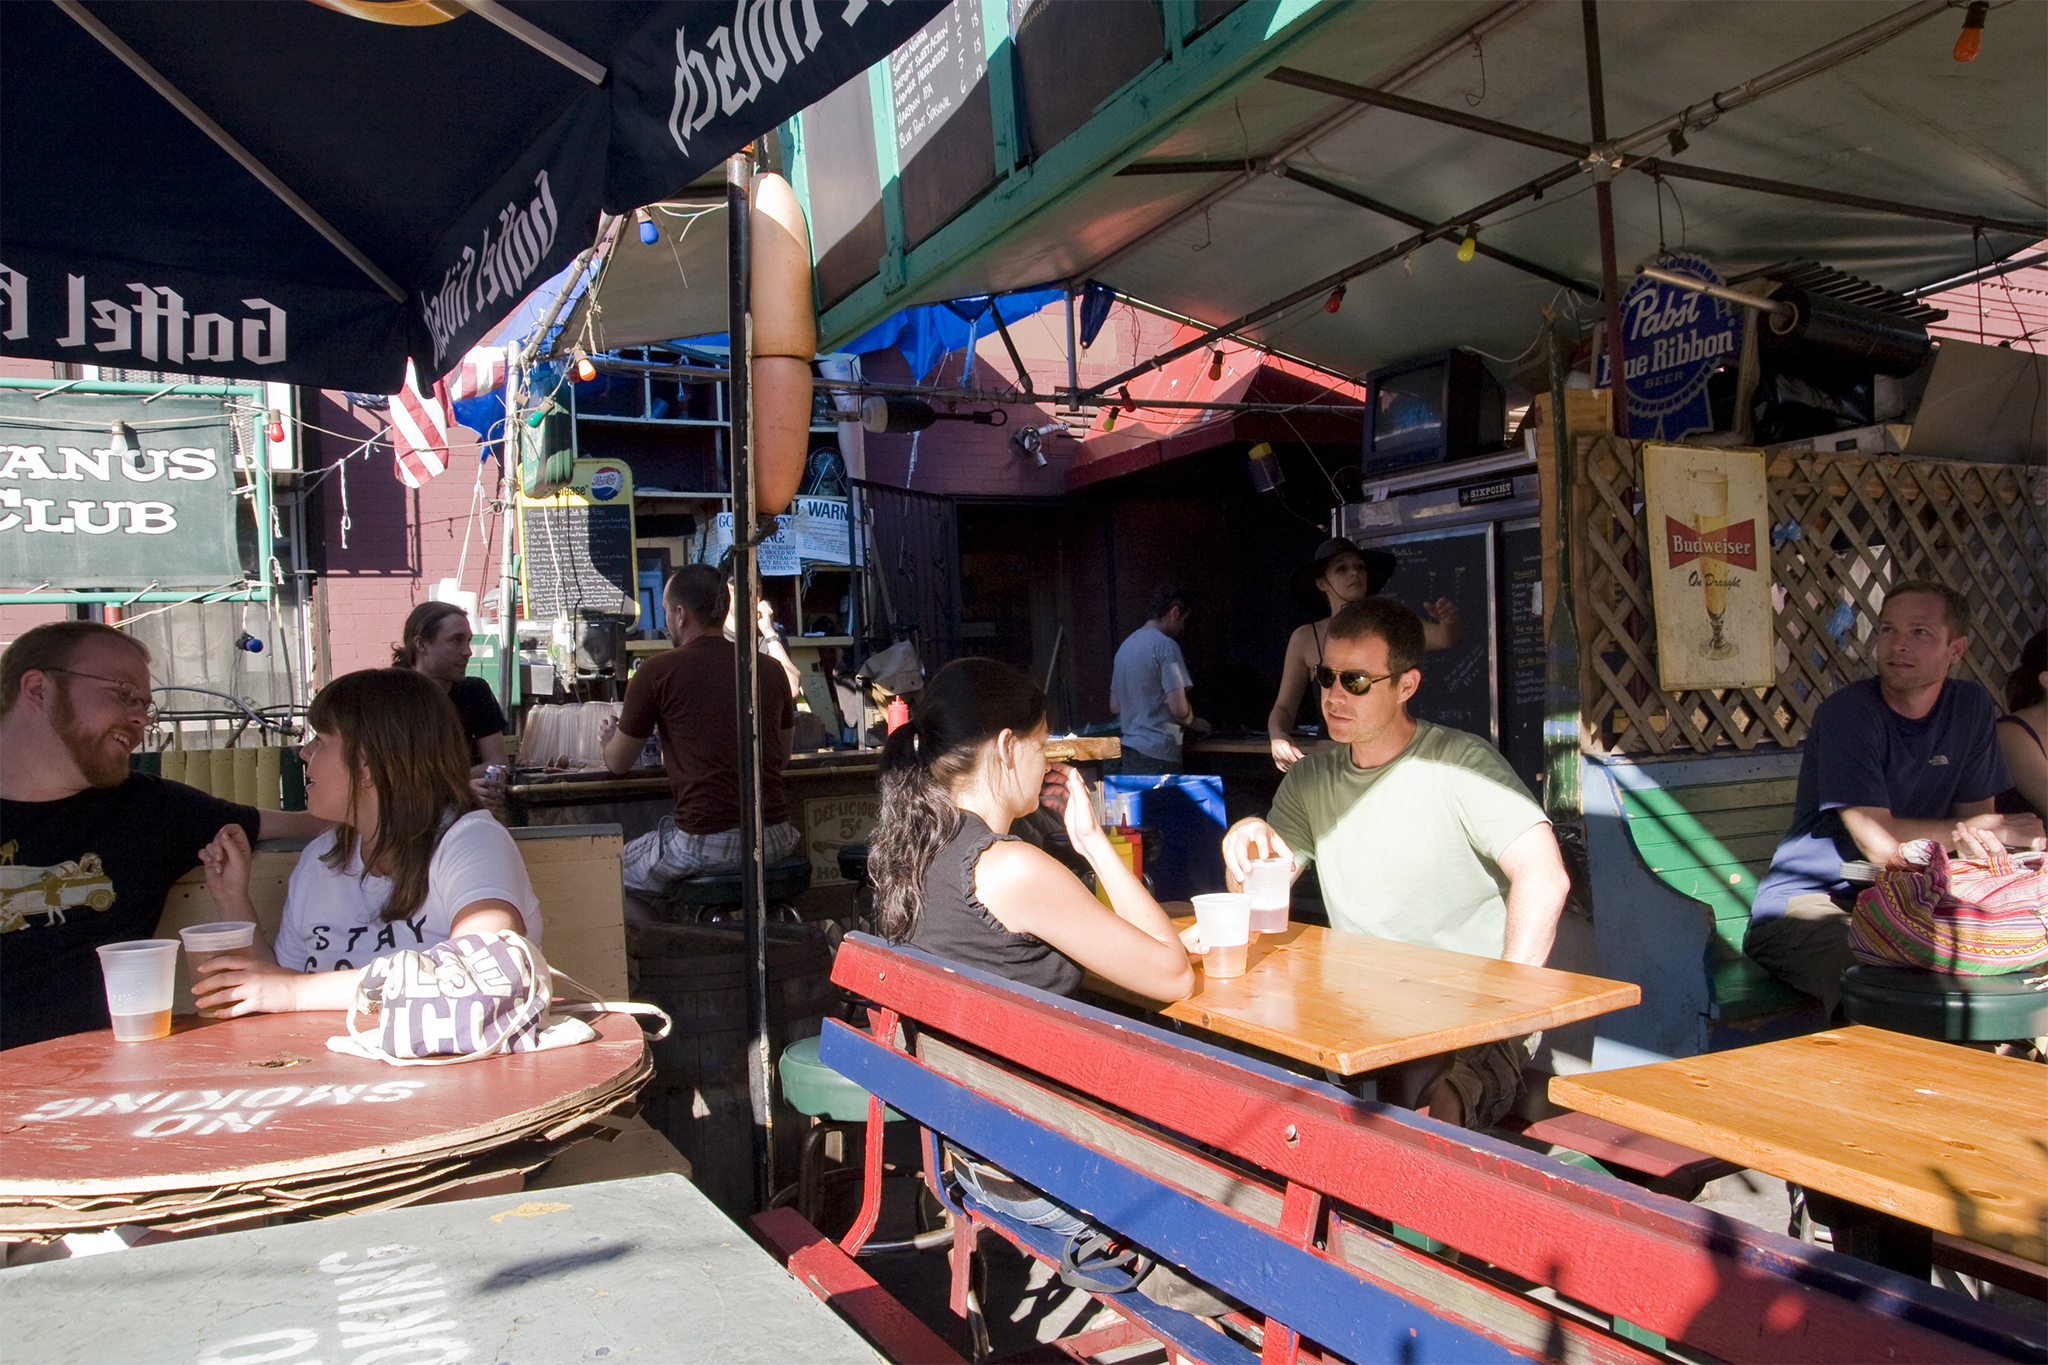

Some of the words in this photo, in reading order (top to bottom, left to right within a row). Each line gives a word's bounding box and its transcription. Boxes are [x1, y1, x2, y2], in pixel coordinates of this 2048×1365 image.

[1629, 288, 1702, 341] Pabst
[1651, 329, 1734, 373] Ribbon
[1645, 370, 1684, 389] BEER
[0, 445, 218, 482] ANUS
[1470, 483, 1512, 498] SIXPOINT
[1672, 534, 1751, 555] Budweiser
[1688, 570, 1703, 587] On
[1704, 573, 1741, 590] Draught
[816, 866, 840, 880] HO
[312, 914, 428, 952] STAY
[18, 1079, 426, 1122] SMOKING
[133, 1109, 277, 1138] NO
